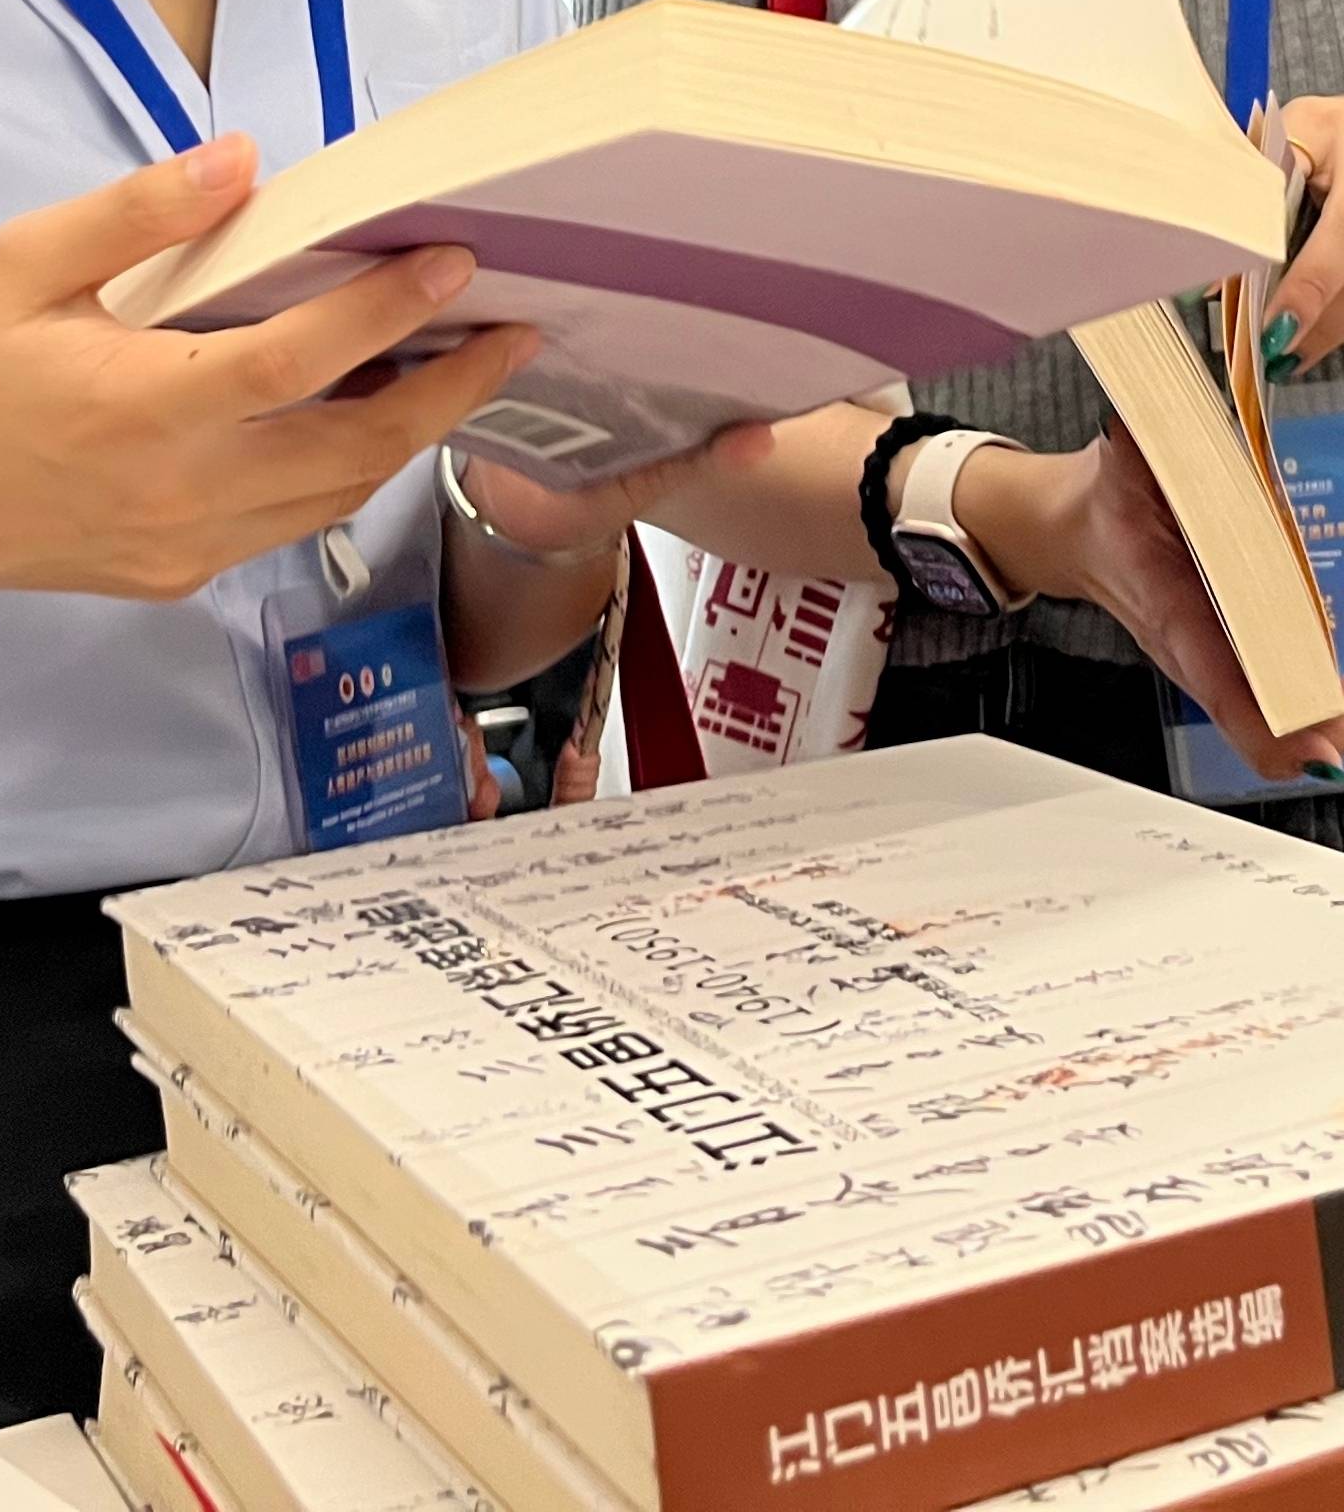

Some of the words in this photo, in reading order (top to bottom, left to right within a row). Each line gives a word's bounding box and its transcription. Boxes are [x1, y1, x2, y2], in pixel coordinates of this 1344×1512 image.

[350, 896, 822, 1172] 江门五邑侨汇档案选编
[583, 913, 850, 1040] (1940-1950)
[769, 1284, 1285, 1485] 江门五邑侨汇档案选编
